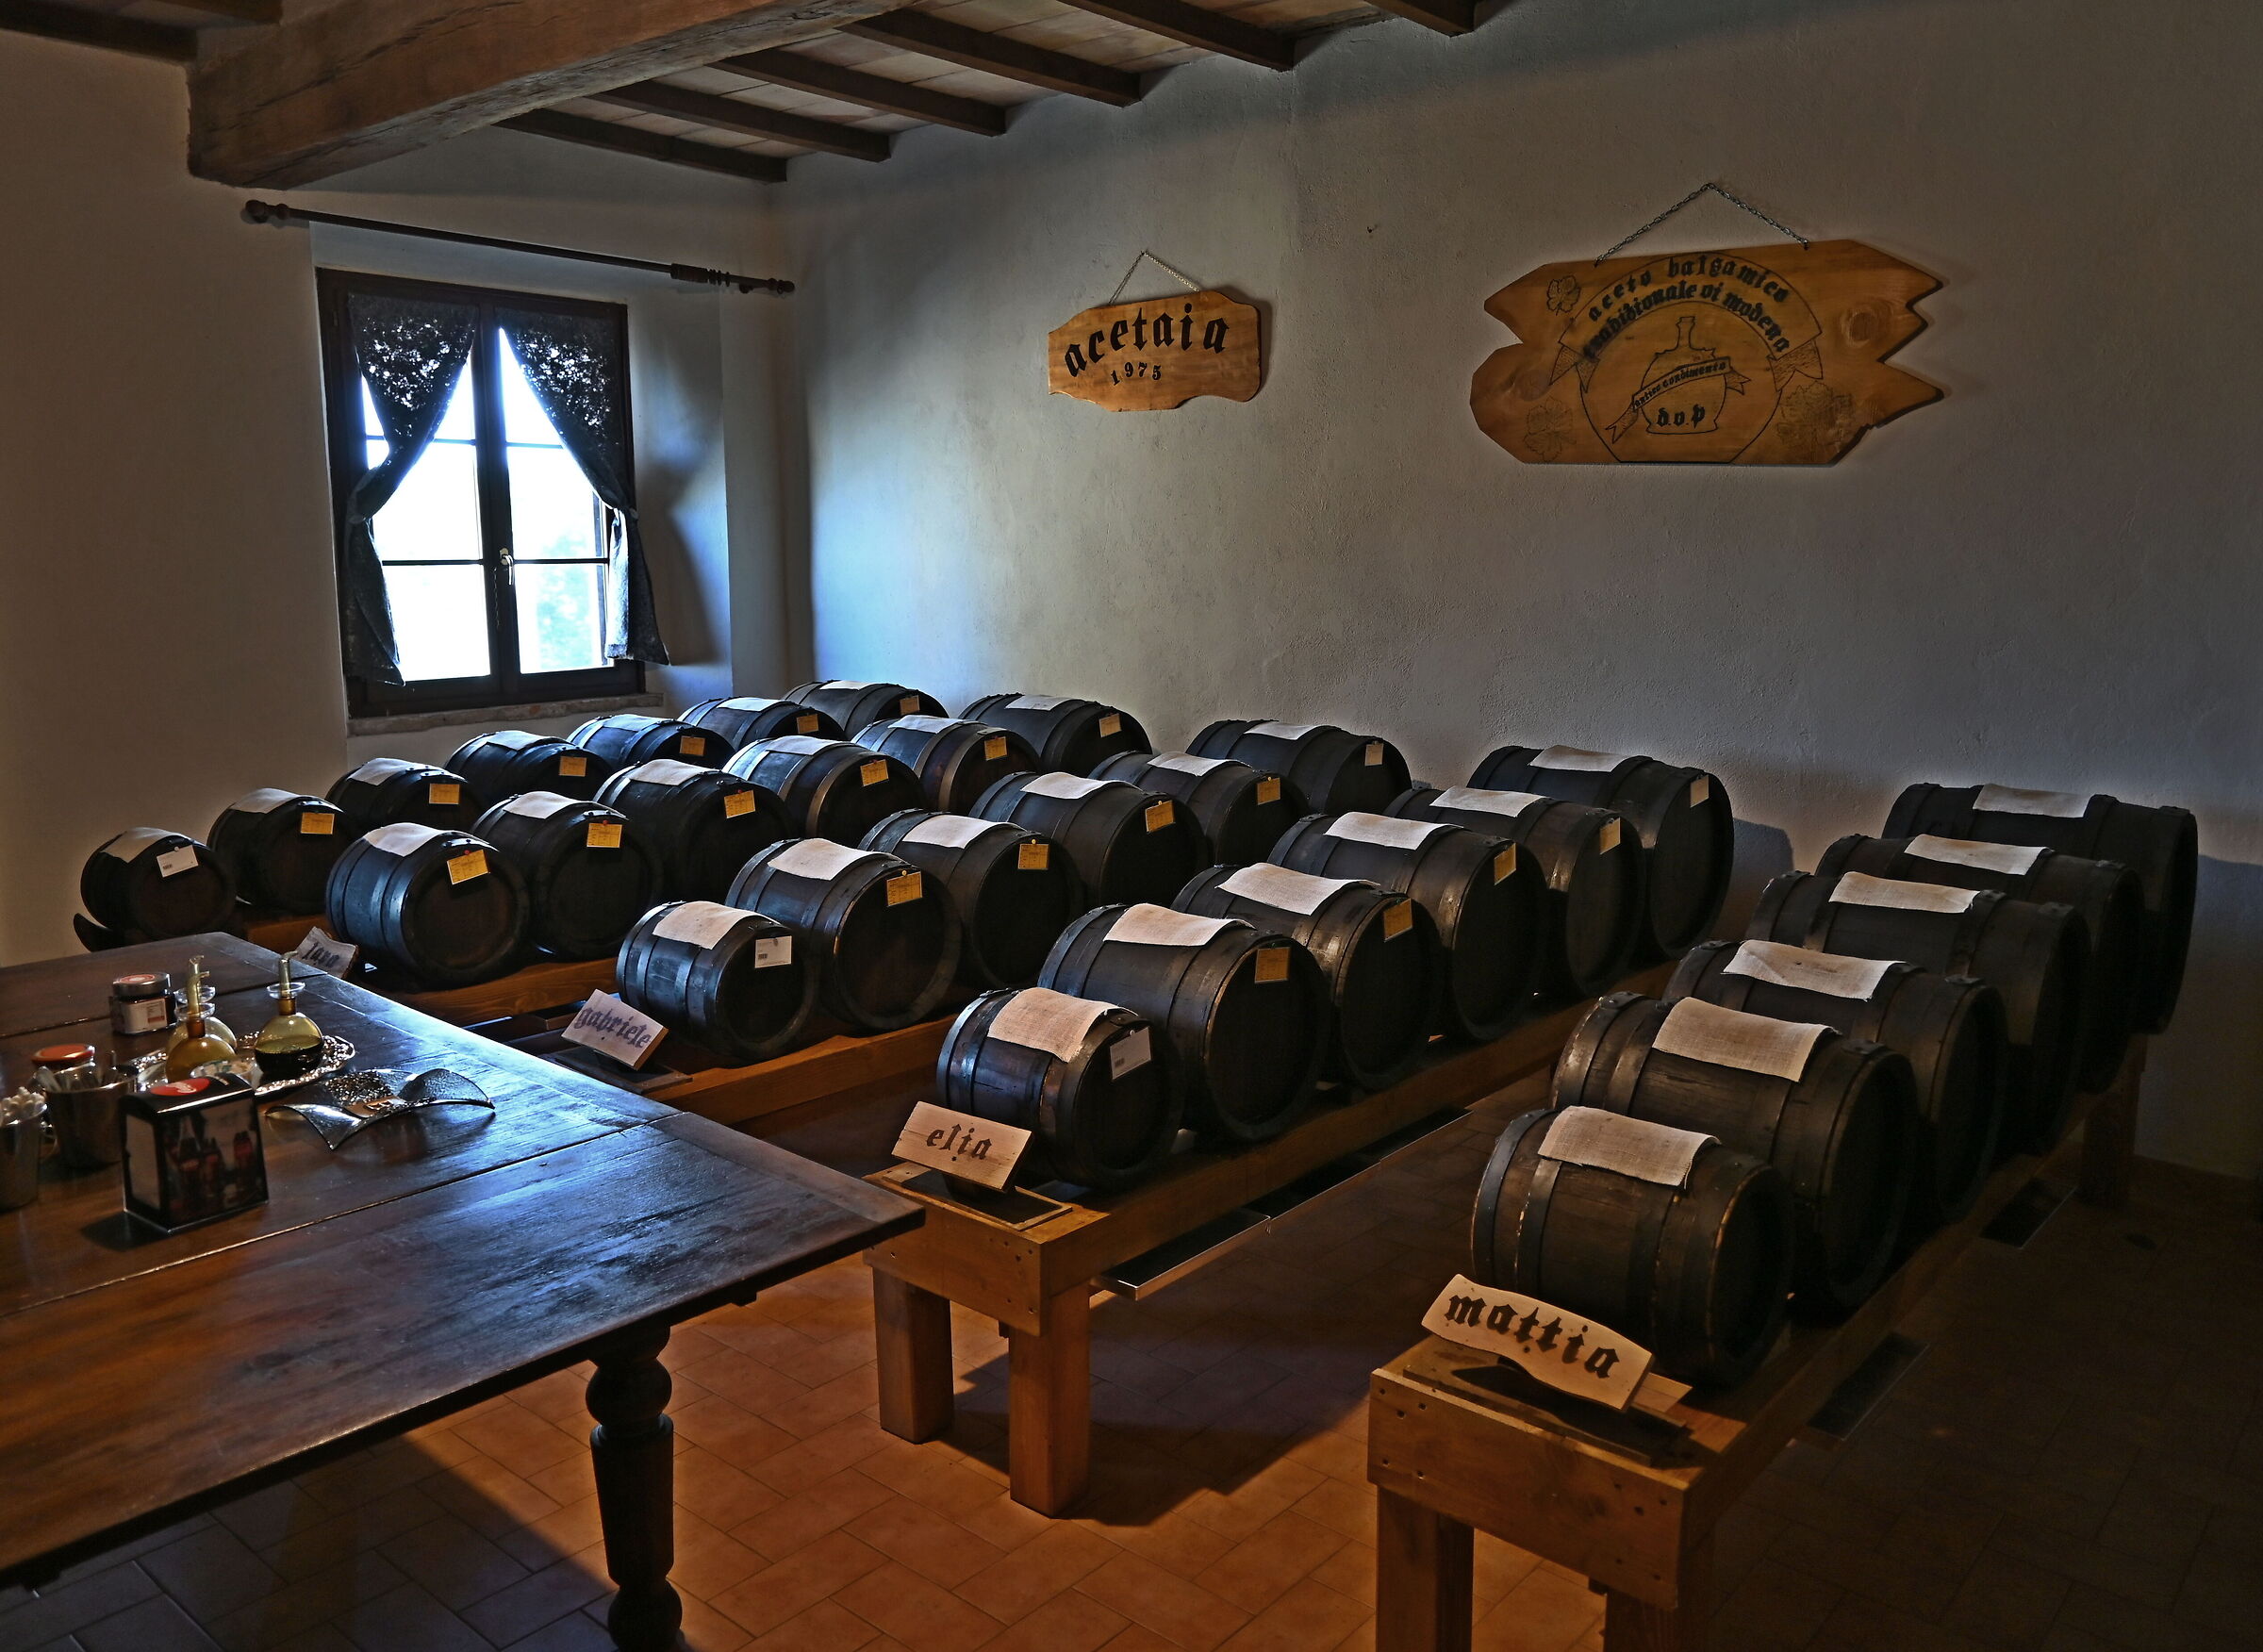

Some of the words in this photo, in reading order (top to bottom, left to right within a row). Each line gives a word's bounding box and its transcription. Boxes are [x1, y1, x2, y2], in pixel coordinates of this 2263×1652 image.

[1589, 270, 1651, 322] aceto
[1667, 255, 1790, 303] balsamico
[1064, 303, 1230, 377] acetaia
[1111, 362, 1162, 386] 1975
[573, 1008, 652, 1048] gabriele
[926, 1123, 992, 1160] elia
[1444, 1295, 1620, 1379] mattia
